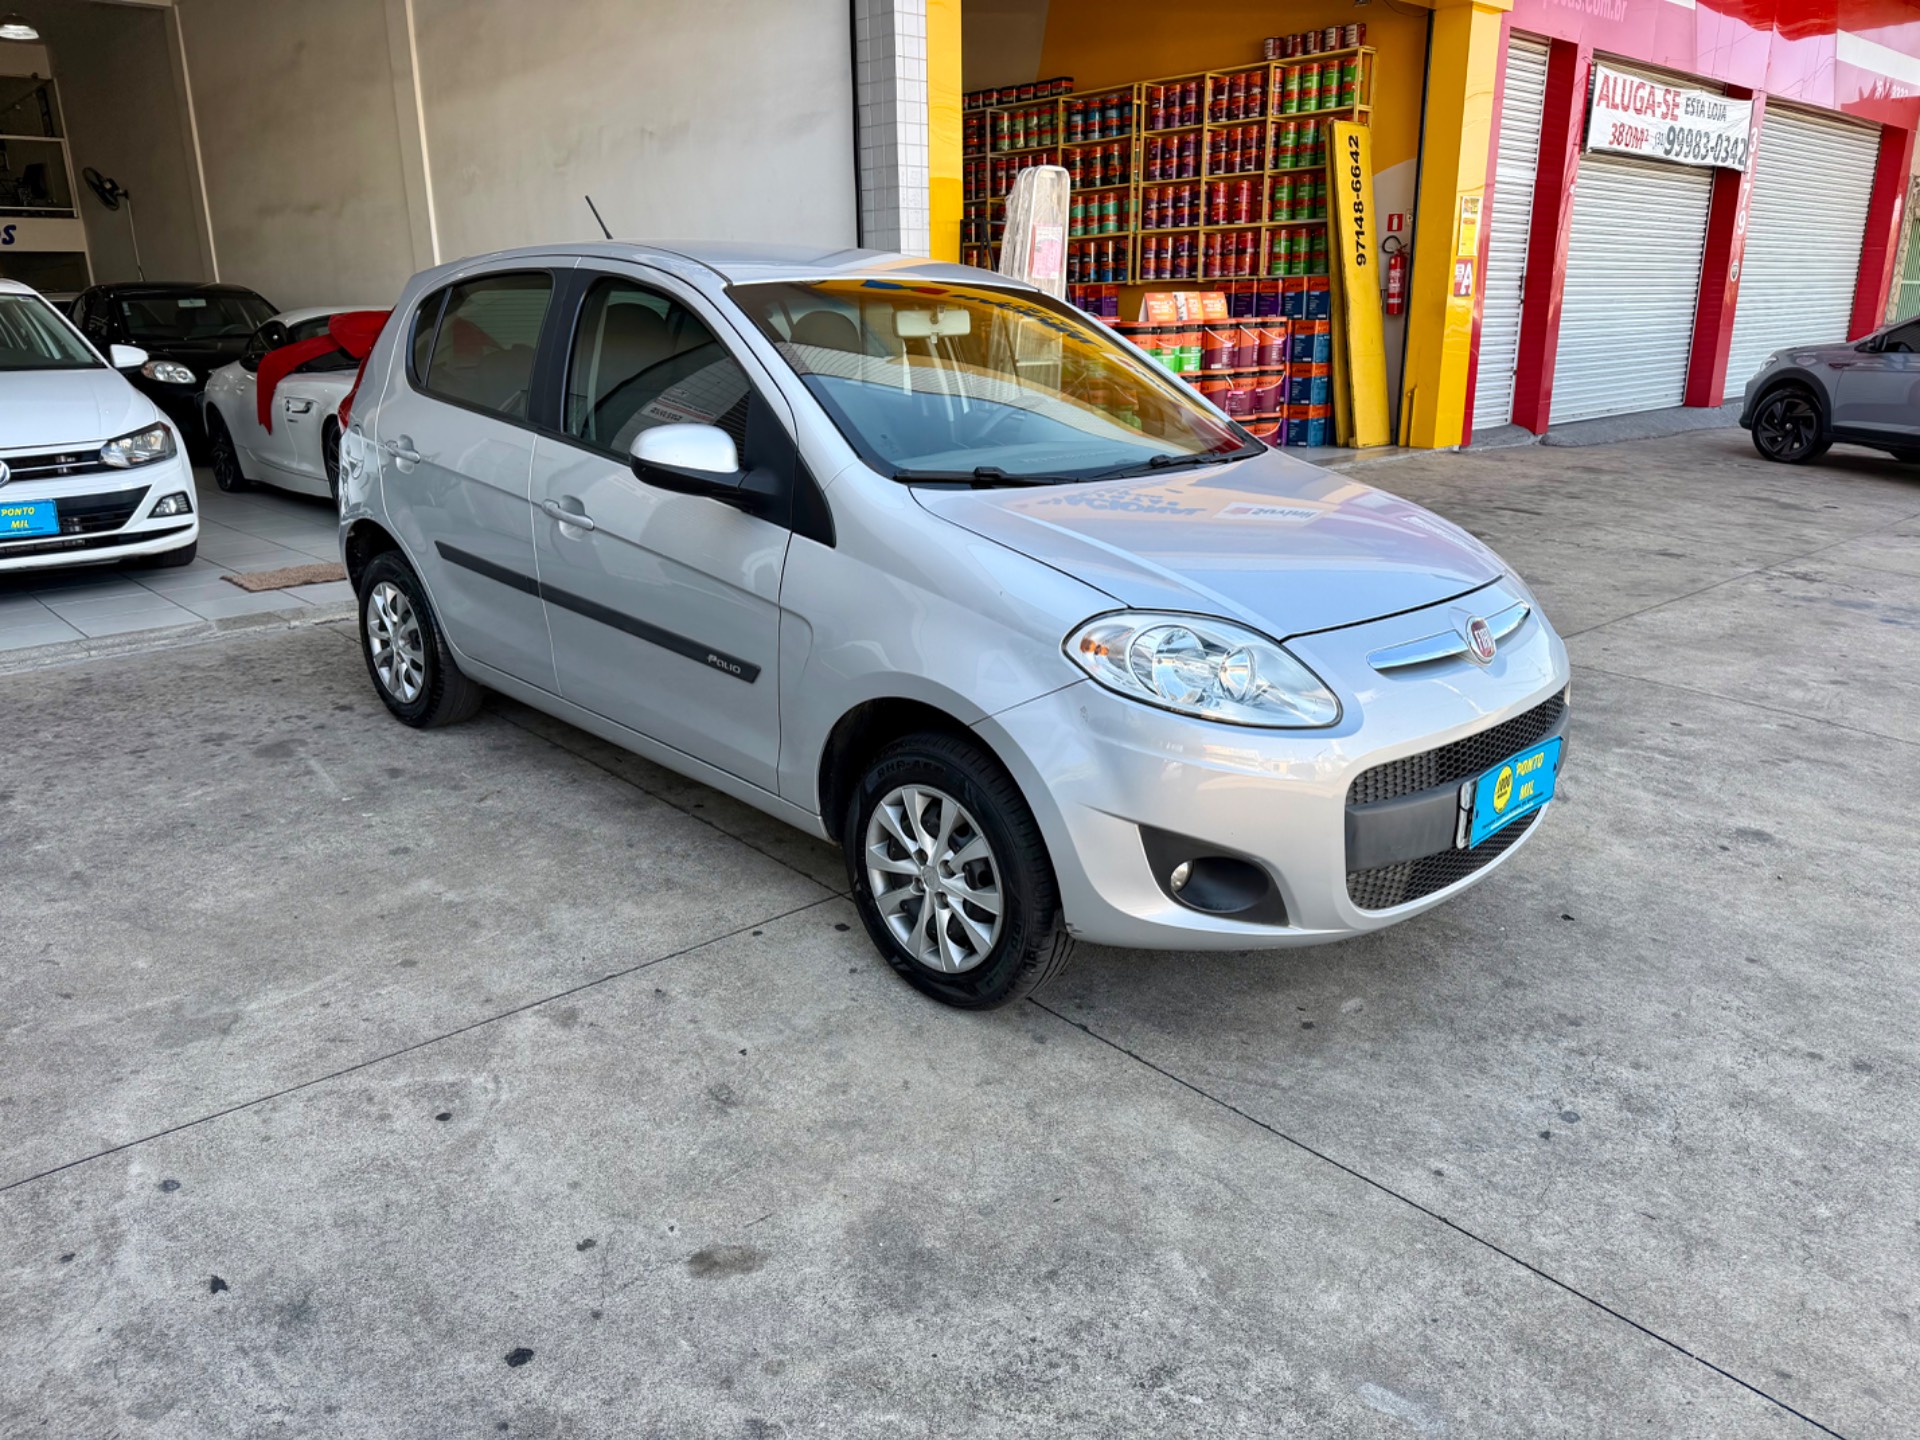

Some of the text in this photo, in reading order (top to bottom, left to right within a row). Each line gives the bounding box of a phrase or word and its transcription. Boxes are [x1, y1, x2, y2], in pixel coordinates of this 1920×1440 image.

[1595, 74, 1727, 122] ALUGA-SE ESTA LOJA
[1664, 125, 1747, 166] 99983-0342
[1348, 135, 1367, 267] 97148-6642
[1, 506, 35, 517] PONTO
[11, 520, 29, 529] MIL
[1515, 752, 1545, 778] PONTO
[1519, 779, 1535, 801] MIL
